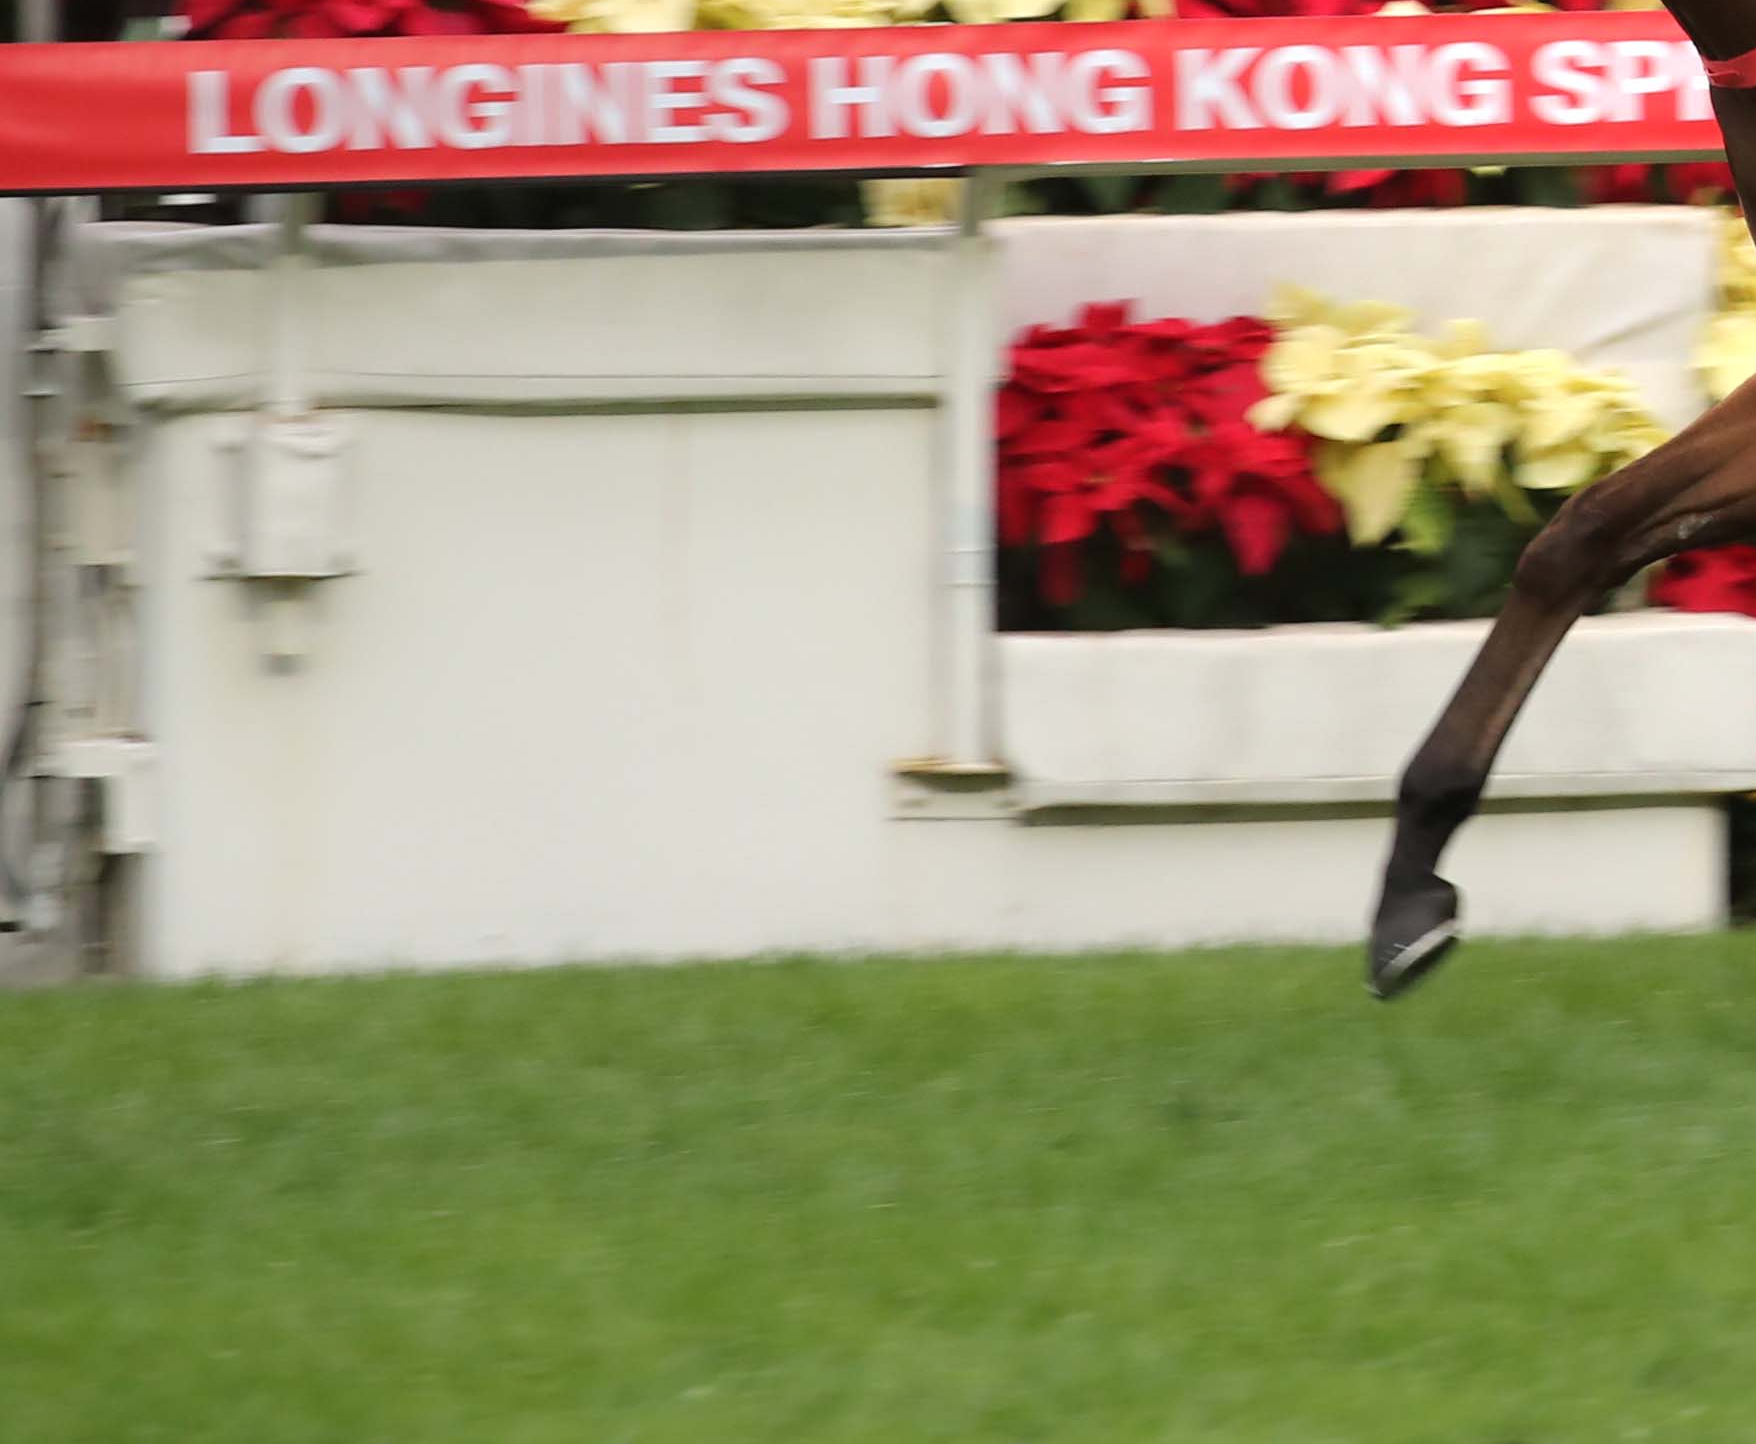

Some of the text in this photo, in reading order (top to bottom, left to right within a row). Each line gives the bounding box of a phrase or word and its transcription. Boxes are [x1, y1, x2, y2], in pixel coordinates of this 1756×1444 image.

[188, 56, 790, 155] LONGINES
[809, 48, 1152, 142] HONG
[1174, 40, 1513, 131] KONG
